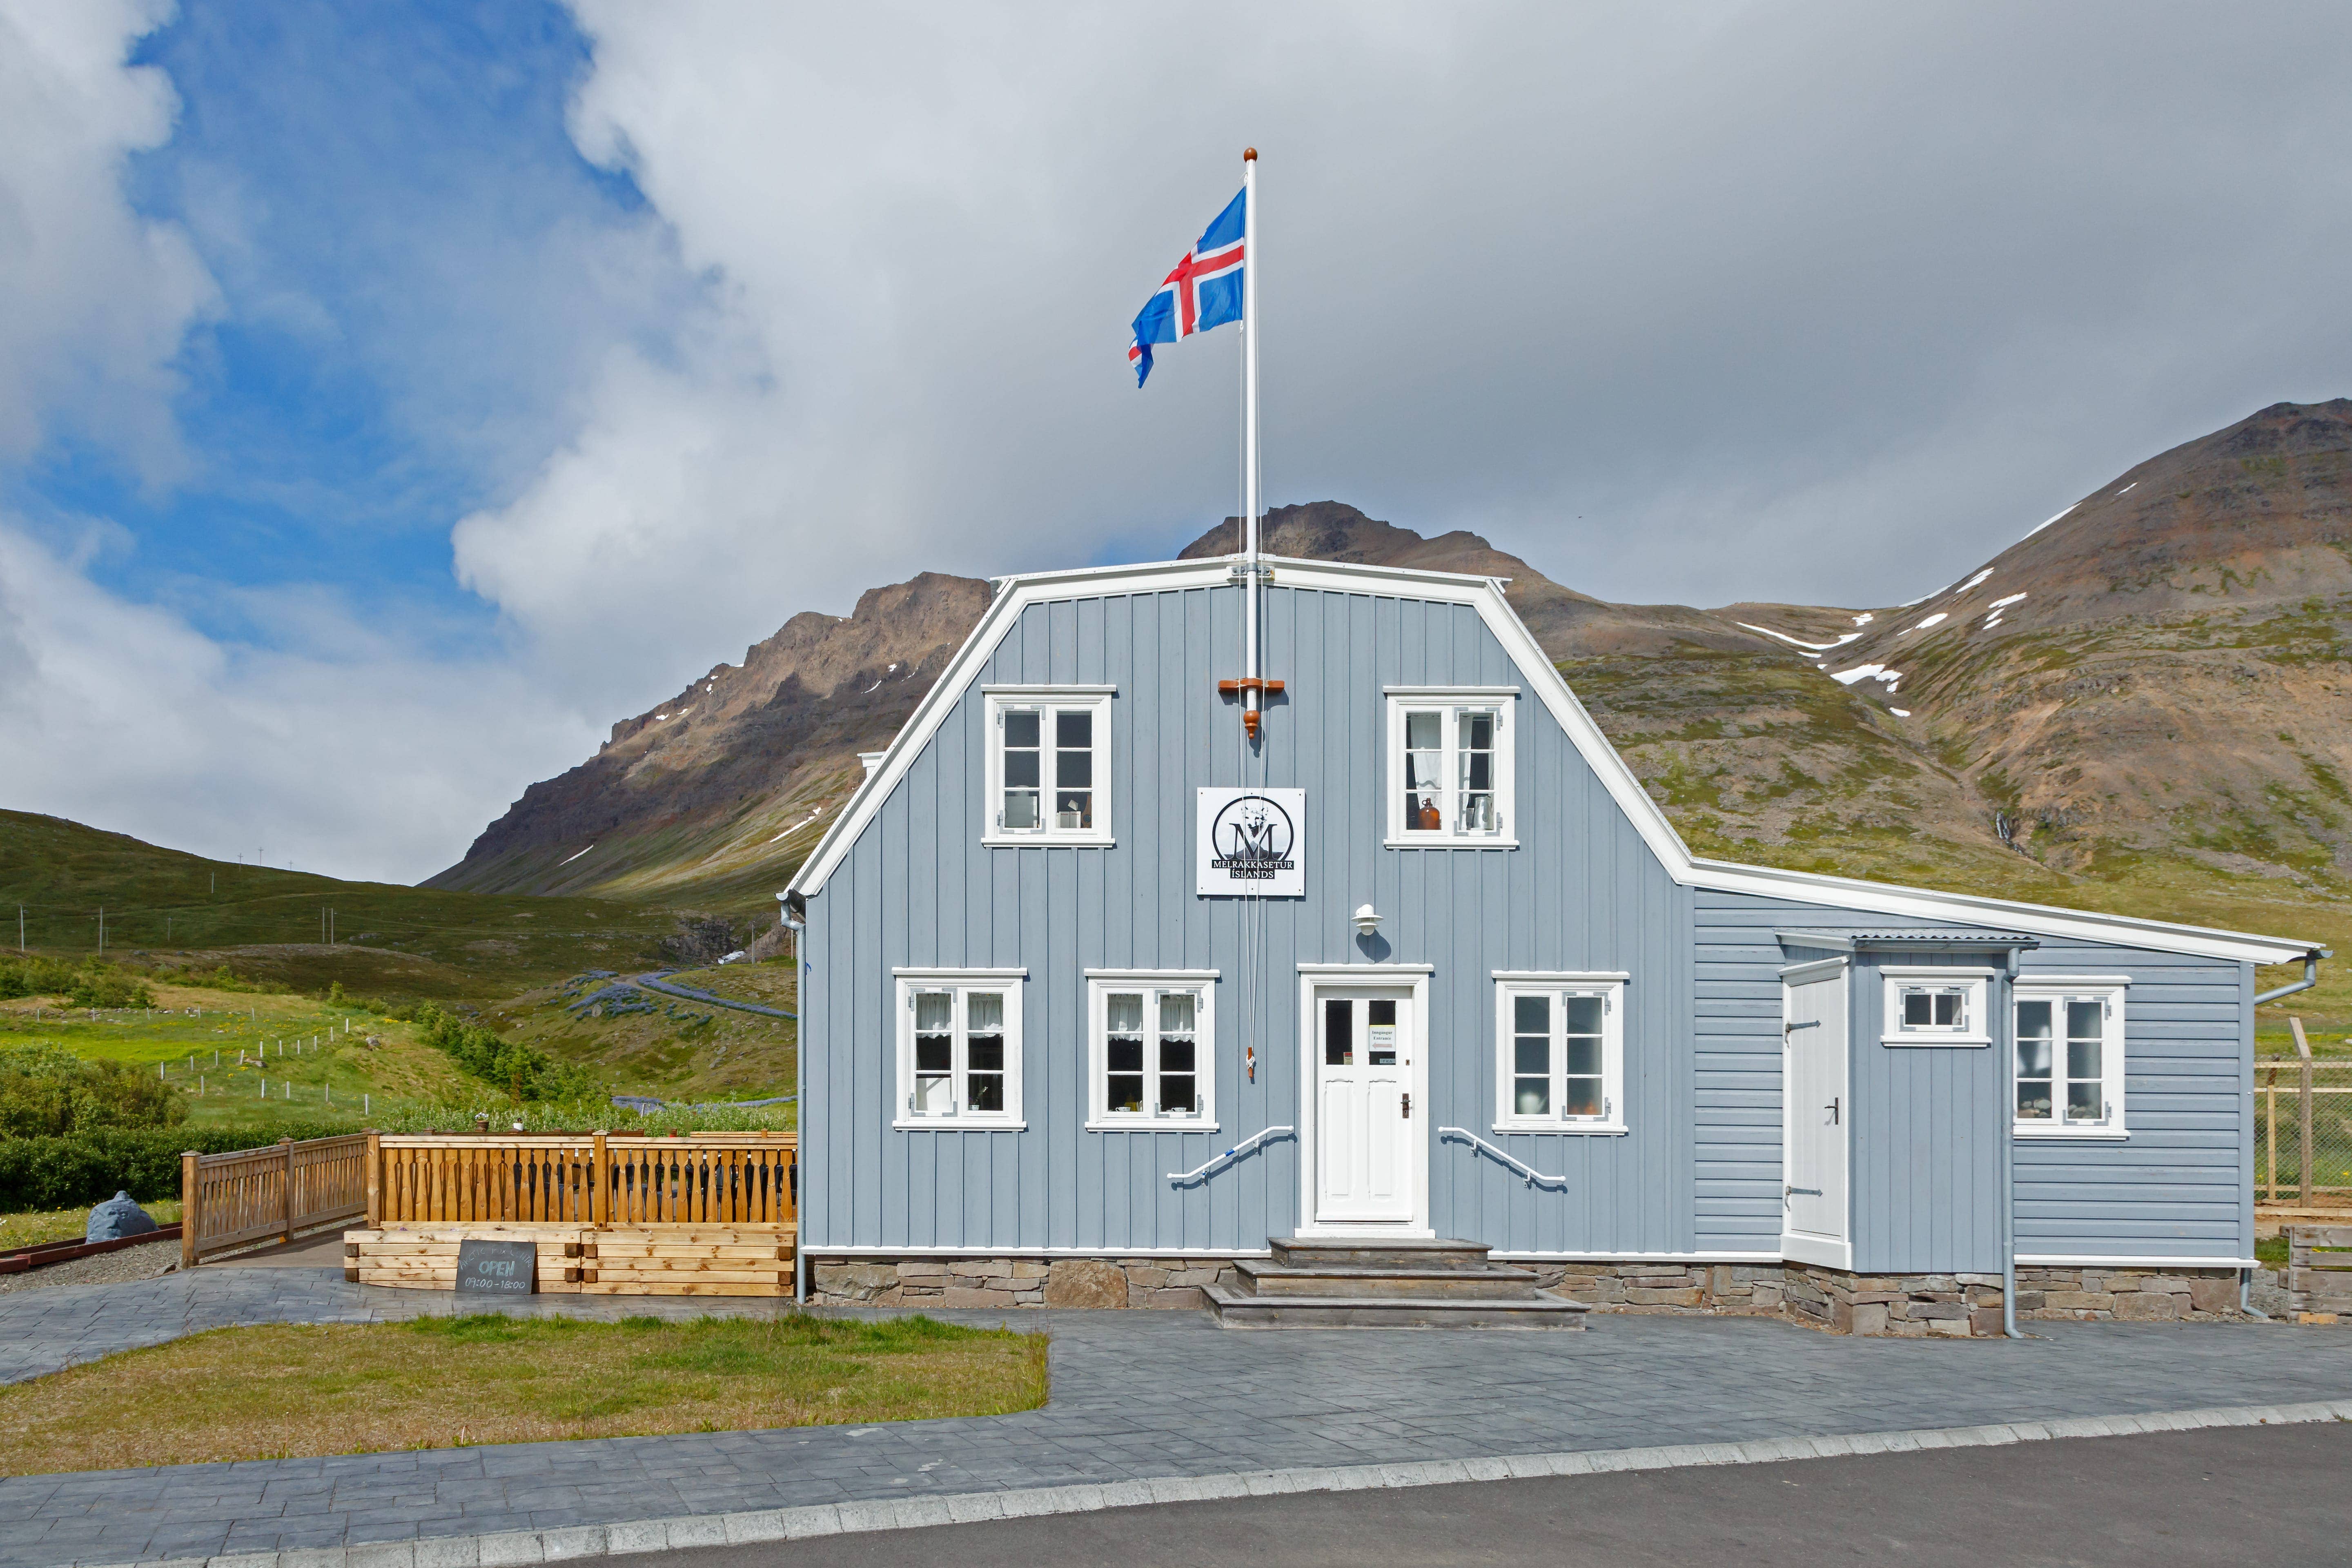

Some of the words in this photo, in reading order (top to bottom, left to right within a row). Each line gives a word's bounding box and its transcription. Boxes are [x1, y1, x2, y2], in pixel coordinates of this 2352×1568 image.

[1229, 823, 1278, 860] M
[1214, 860, 1293, 869] MELRAKKASETUR
[1232, 869, 1274, 878] ÍSLANDS
[479, 1261, 515, 1277] OPEN
